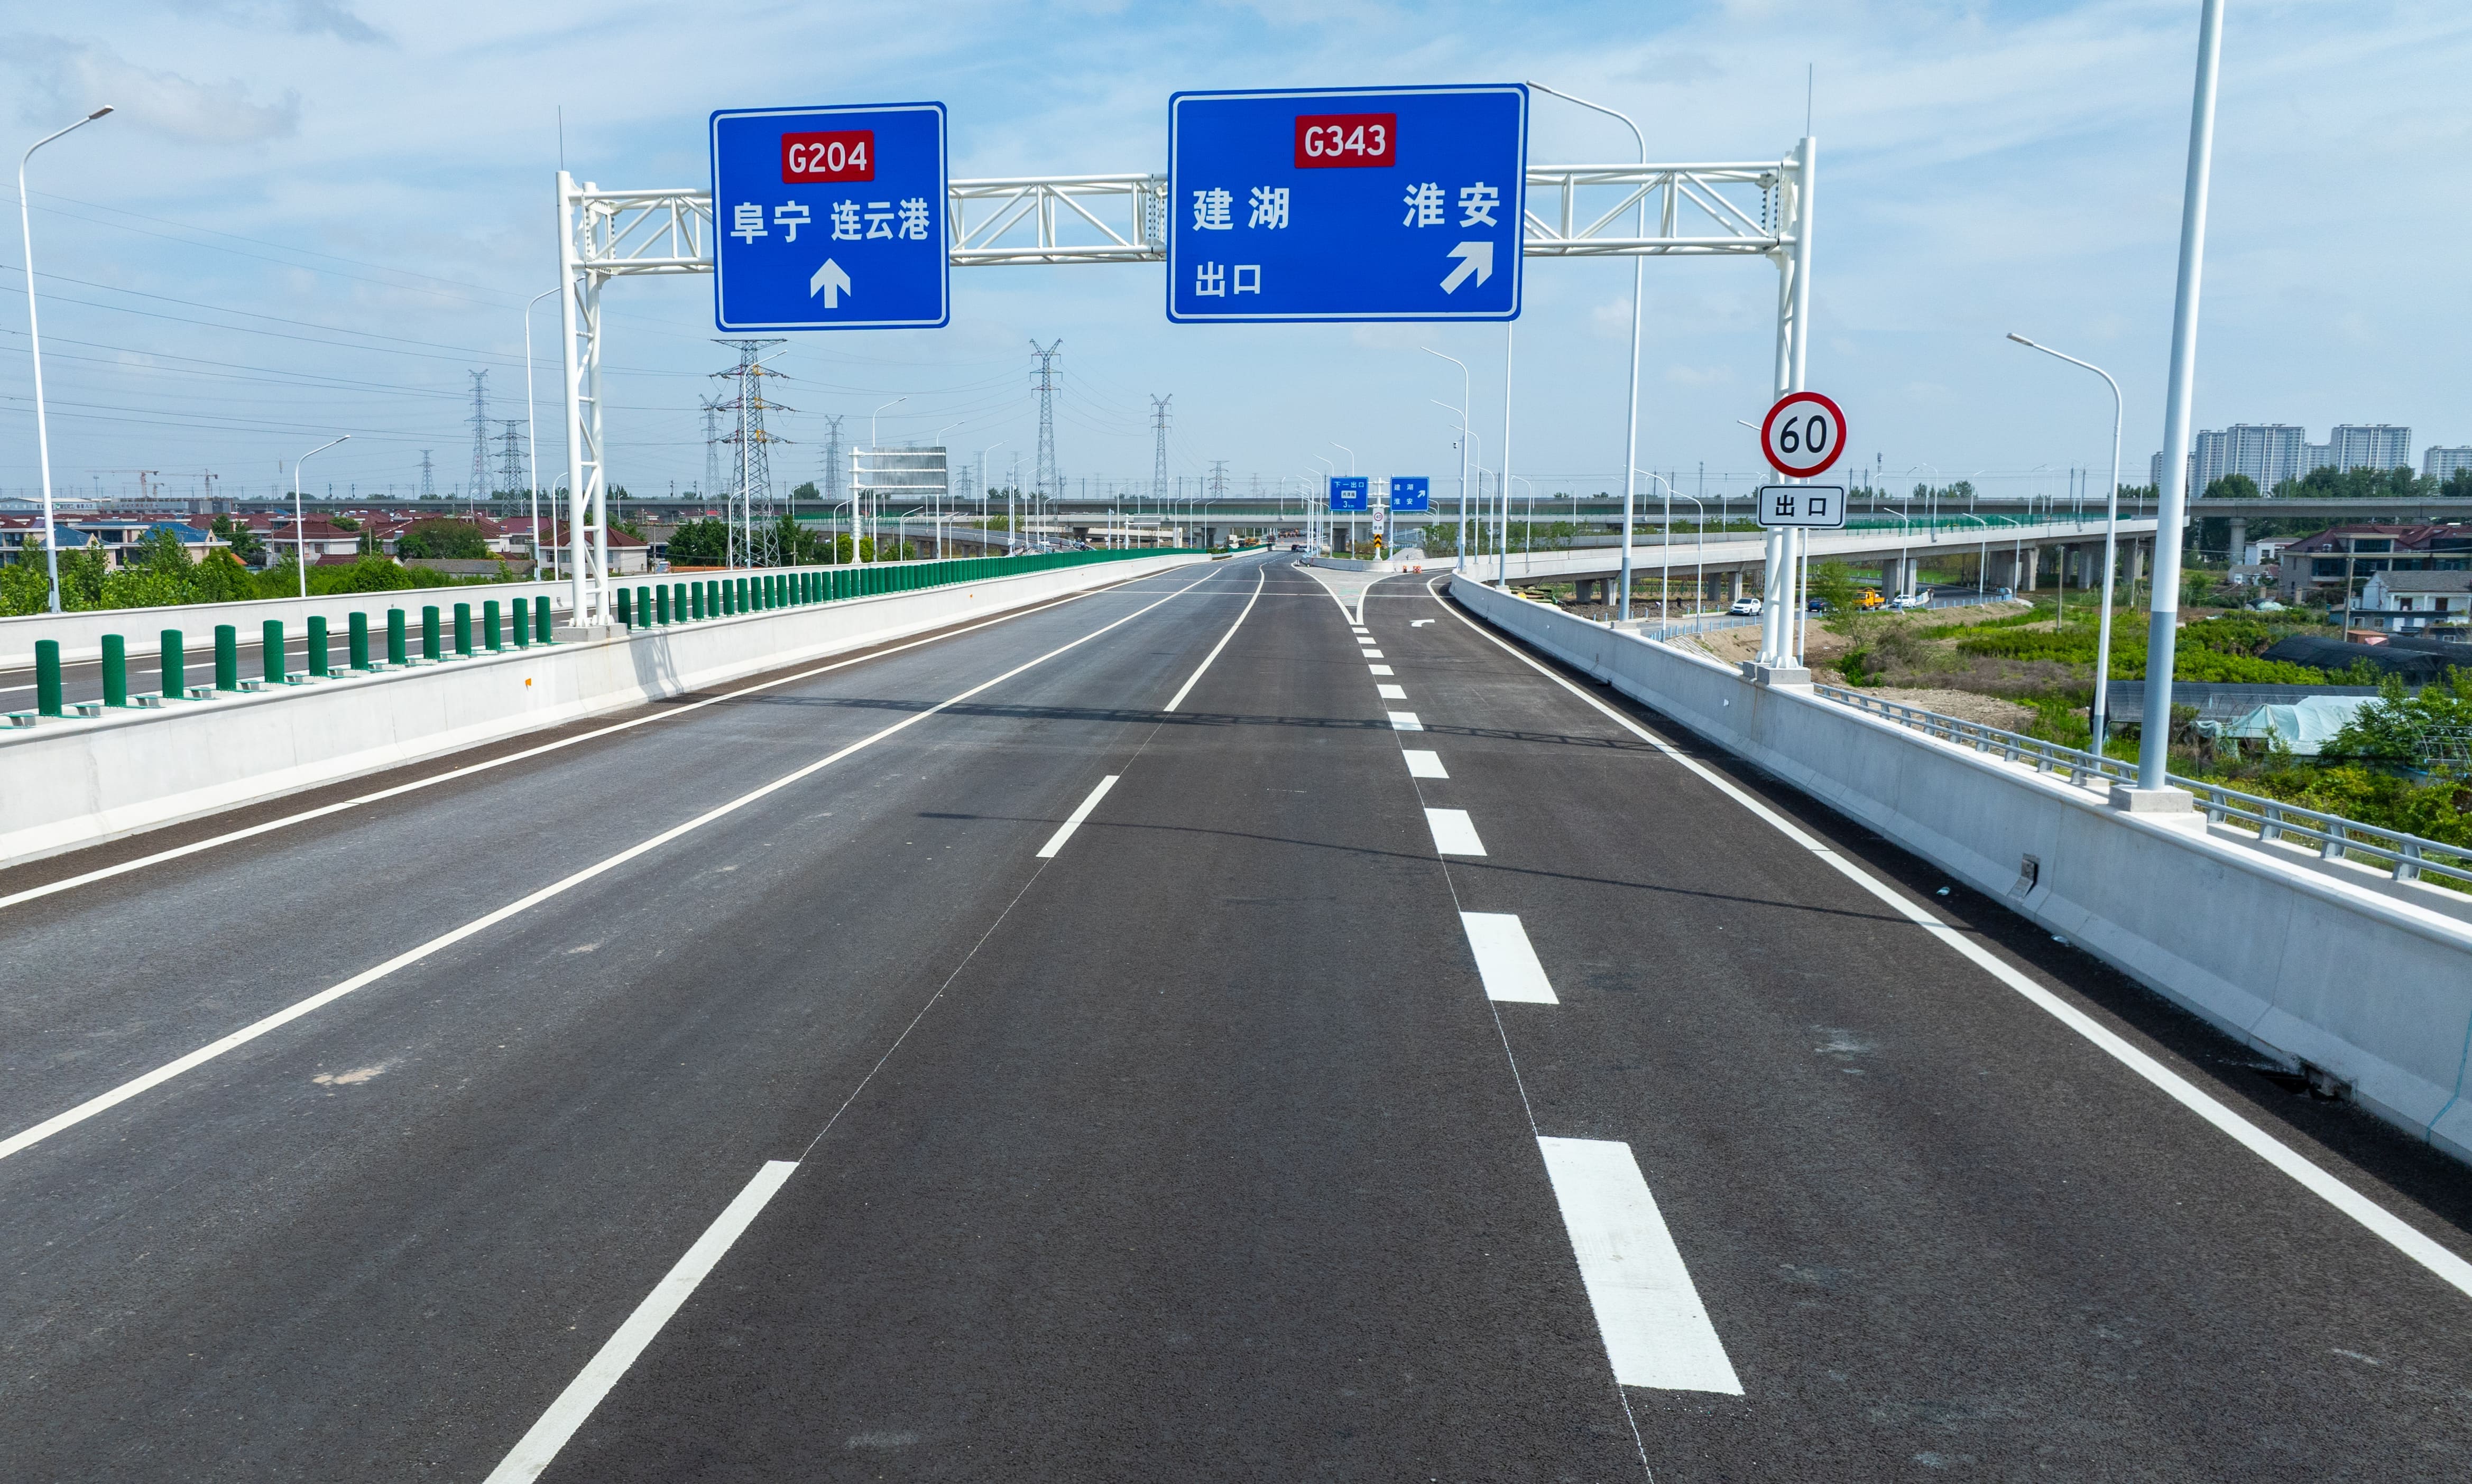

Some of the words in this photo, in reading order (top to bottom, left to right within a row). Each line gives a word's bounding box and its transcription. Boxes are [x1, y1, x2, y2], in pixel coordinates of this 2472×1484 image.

[789, 142, 867, 173] G204
[1305, 125, 1386, 157] G343
[731, 200, 811, 244] 阜宁
[831, 198, 930, 242] 连云港
[1196, 261, 1261, 298] 出口
[1780, 415, 1827, 453] 60
[1775, 495, 1827, 517] 出口
